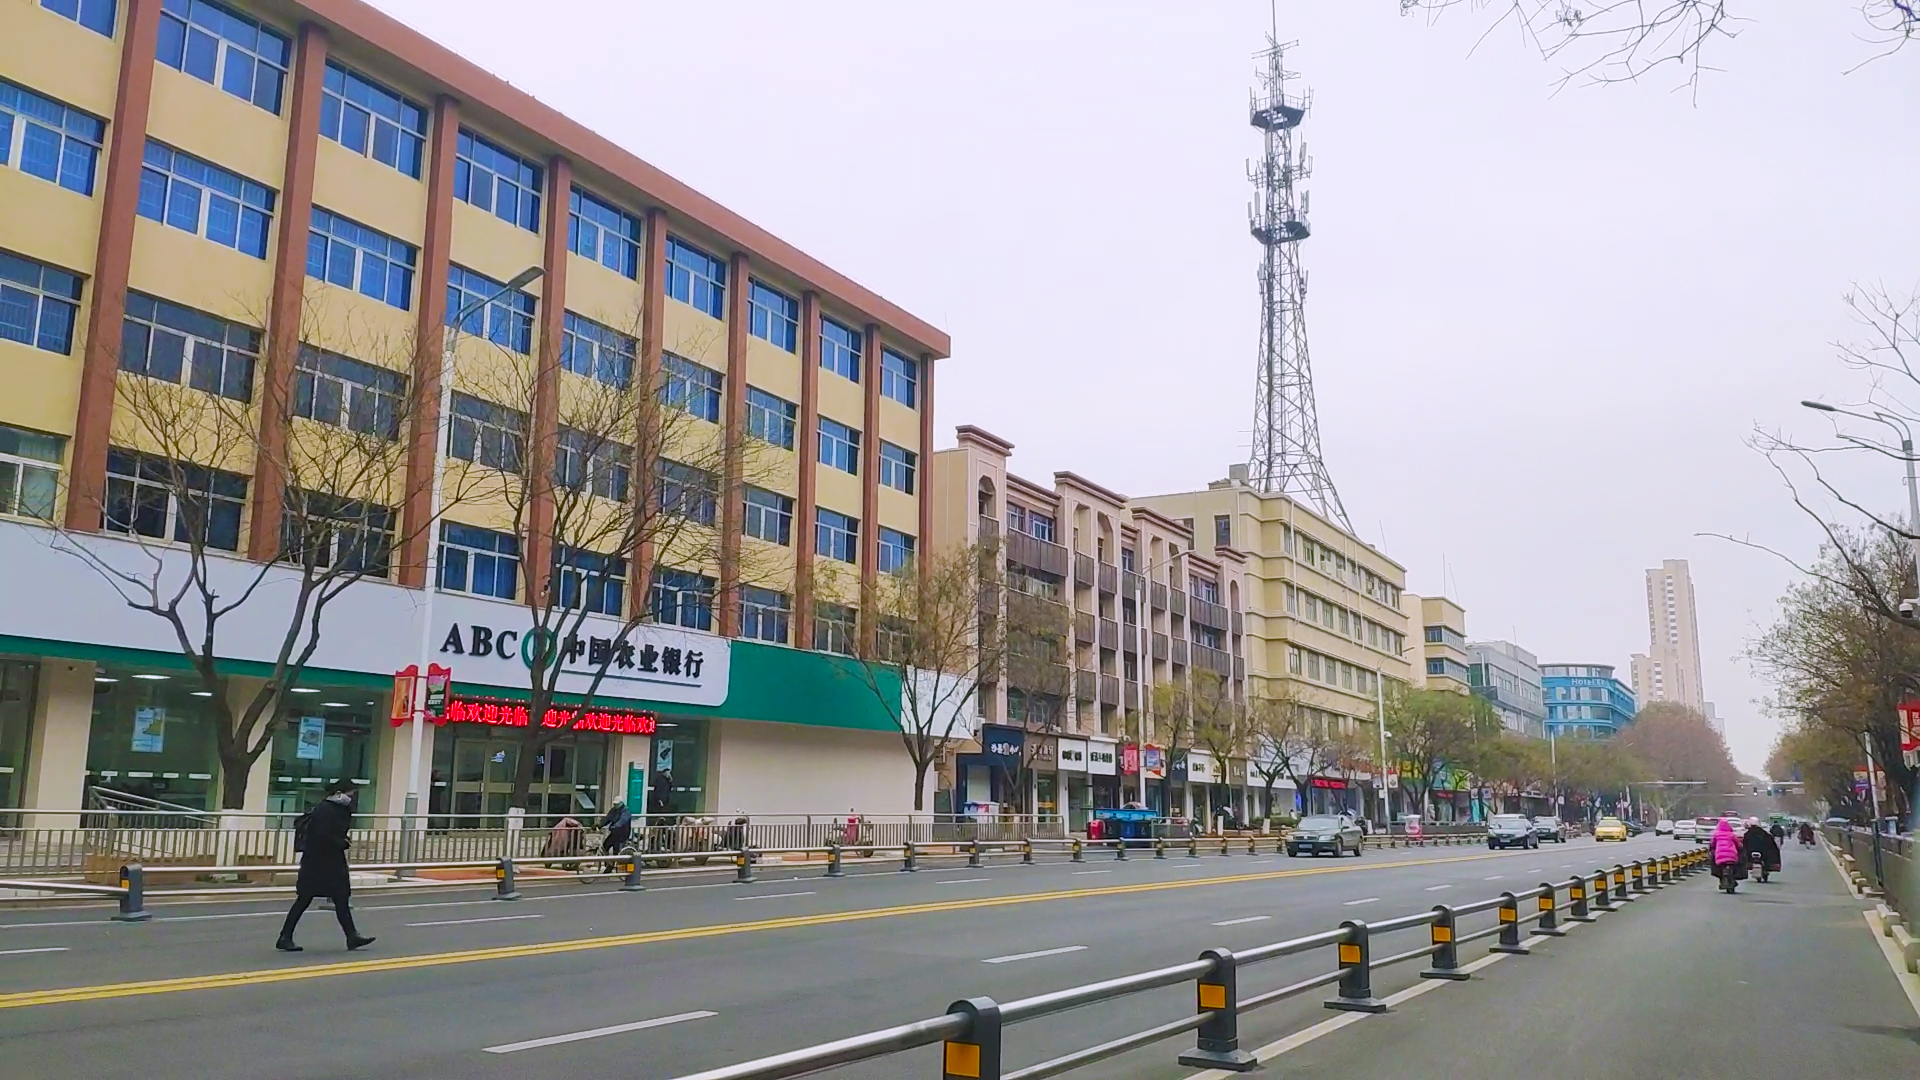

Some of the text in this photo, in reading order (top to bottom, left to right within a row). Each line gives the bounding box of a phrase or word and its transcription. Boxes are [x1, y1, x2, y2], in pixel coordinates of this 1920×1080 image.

[439, 623, 518, 659] ABC
[562, 633, 705, 678] 中国农业银行
